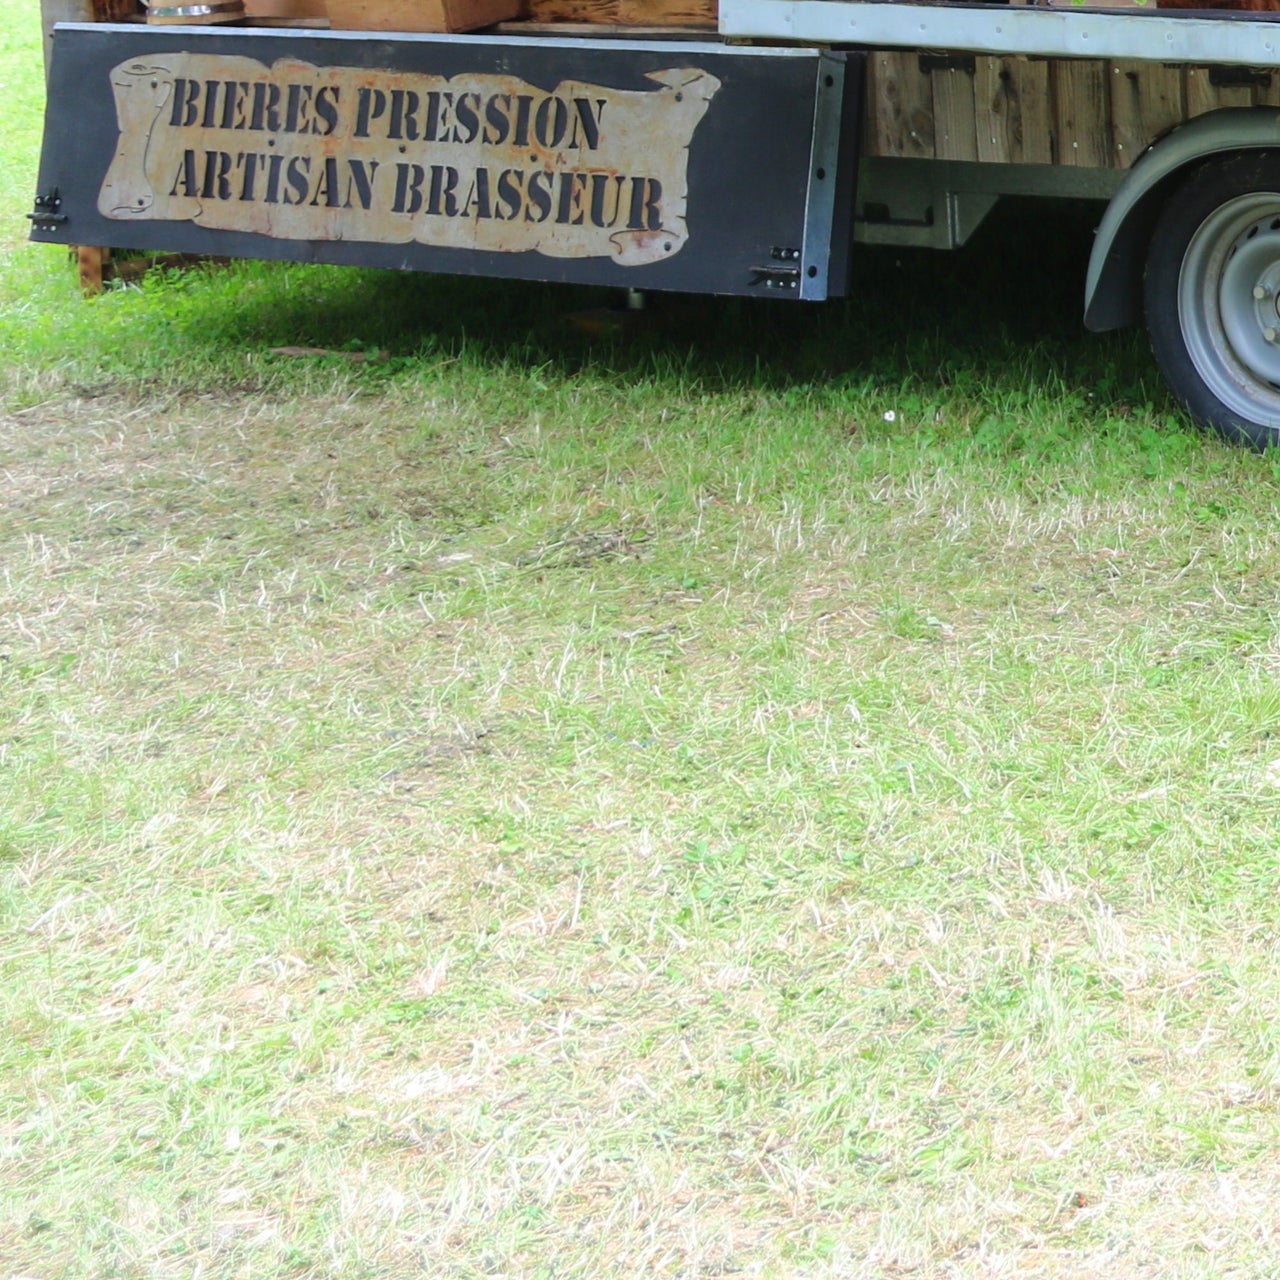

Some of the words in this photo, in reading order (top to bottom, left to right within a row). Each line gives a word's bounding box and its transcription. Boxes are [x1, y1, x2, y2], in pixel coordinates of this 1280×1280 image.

[169, 78, 340, 136] BIERES
[353, 87, 607, 150] PRESSION
[169, 149, 380, 210] ARTISAN
[391, 162, 664, 231] BRASSEUR
